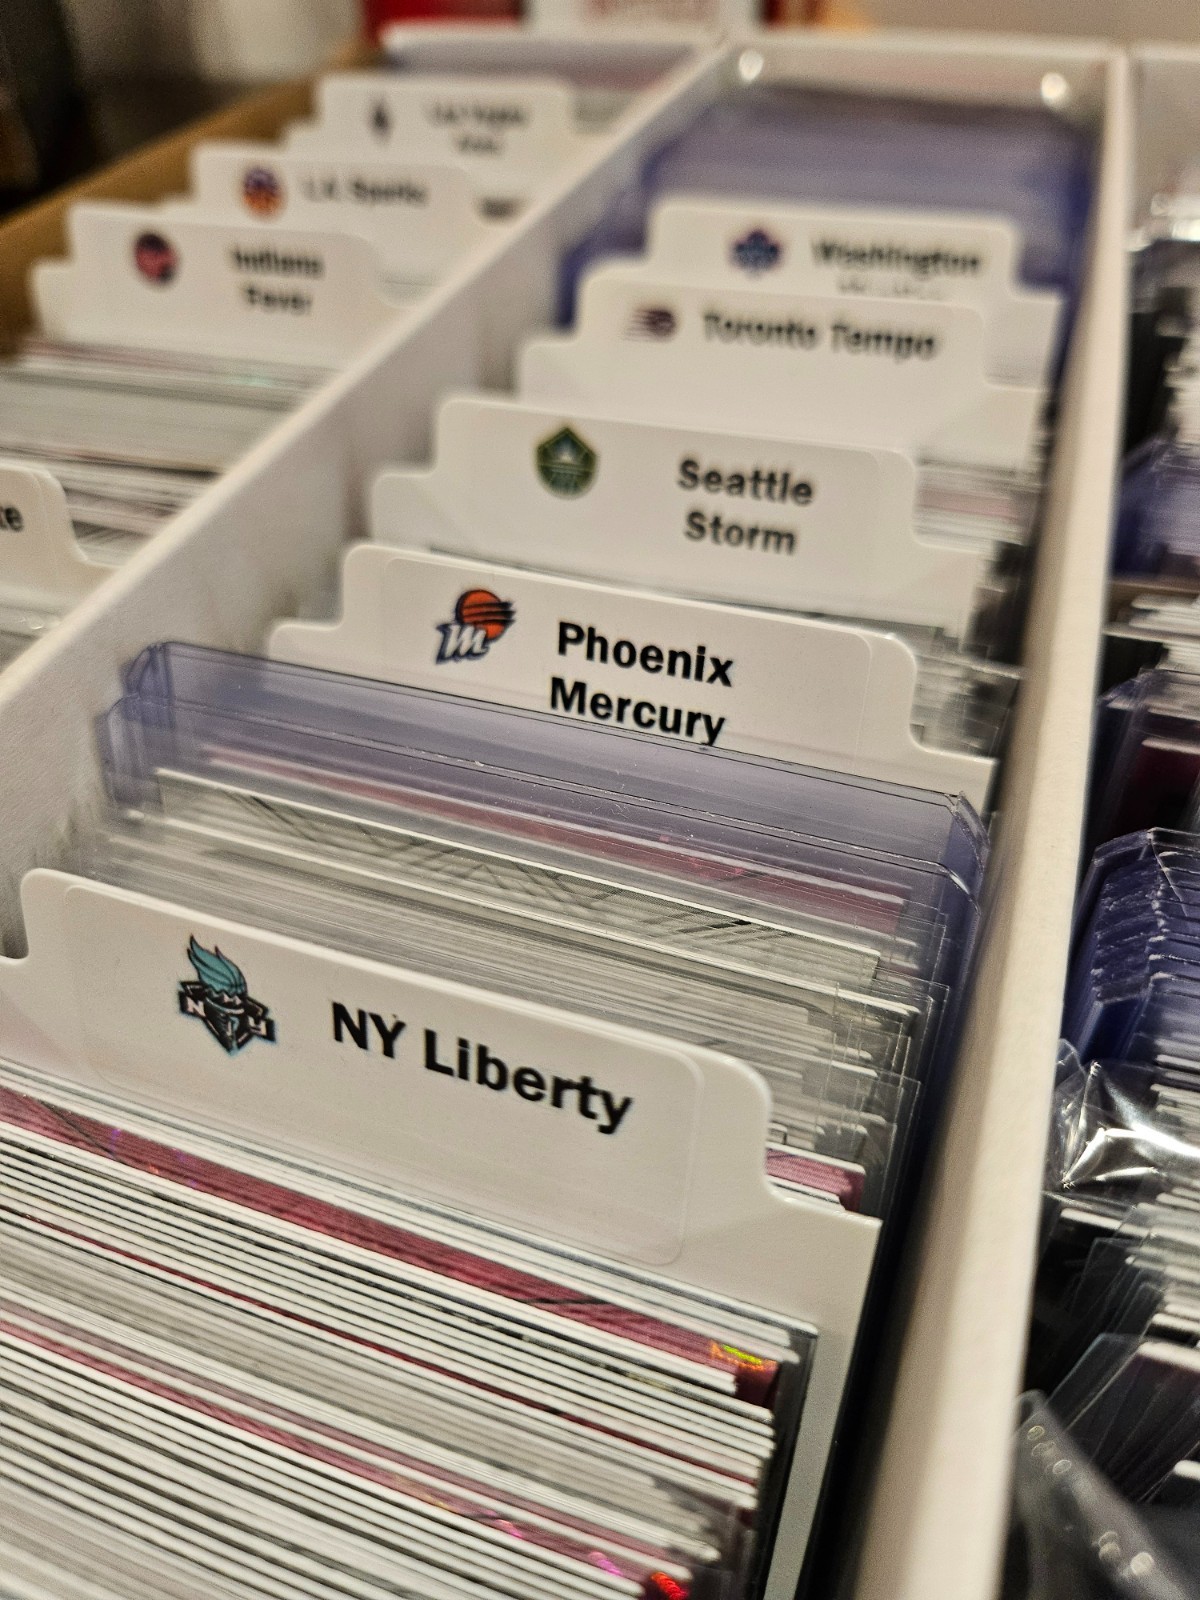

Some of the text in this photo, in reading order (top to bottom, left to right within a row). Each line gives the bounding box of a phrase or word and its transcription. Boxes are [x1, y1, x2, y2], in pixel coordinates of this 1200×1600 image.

[702, 309, 938, 363] Toronto Tempo
[678, 457, 814, 507] Seattle
[685, 509, 797, 555] Storm
[556, 620, 734, 687] Phoenix
[549, 675, 726, 747] Mercury
[332, 1001, 633, 1135] NY Liberty
